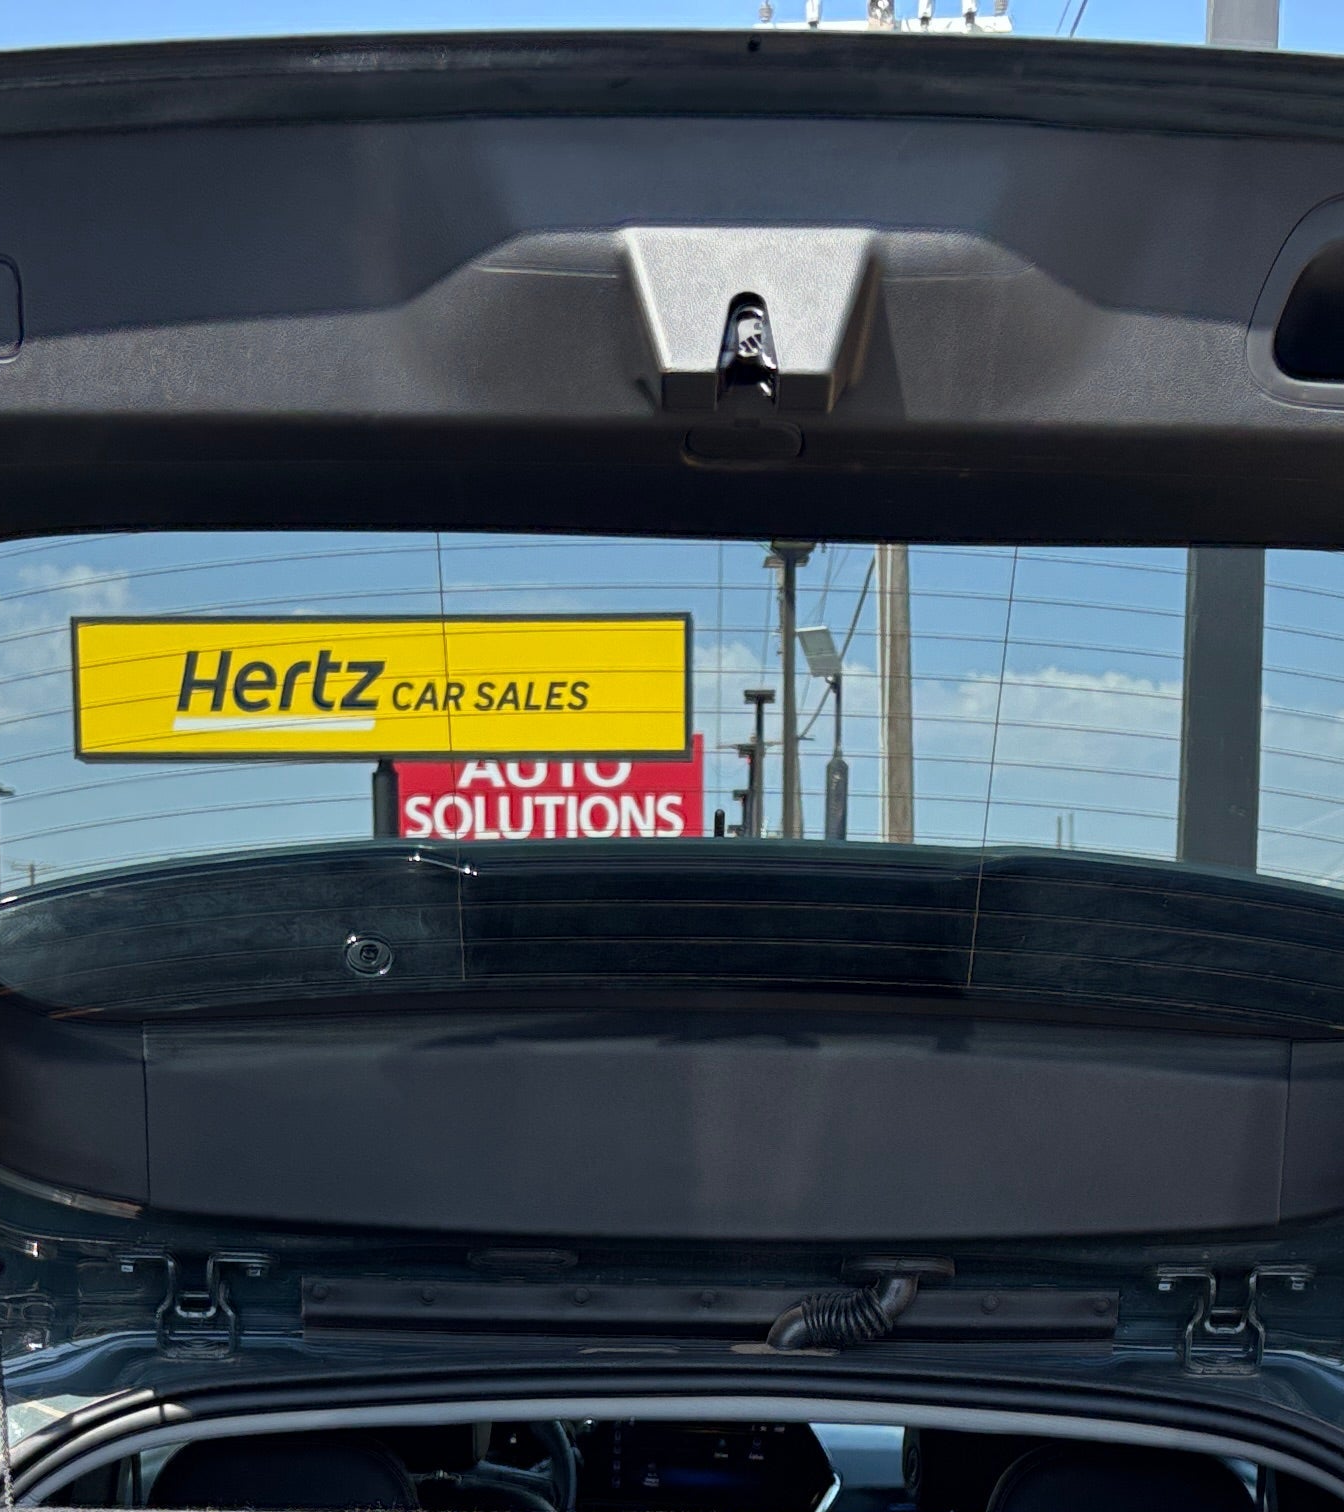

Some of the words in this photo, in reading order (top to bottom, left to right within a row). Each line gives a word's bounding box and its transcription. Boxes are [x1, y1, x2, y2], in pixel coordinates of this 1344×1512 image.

[177, 650, 385, 712] Hertz
[391, 681, 465, 711] CAR
[473, 681, 590, 711] SALES
[404, 794, 686, 840] SOLUTIONS
